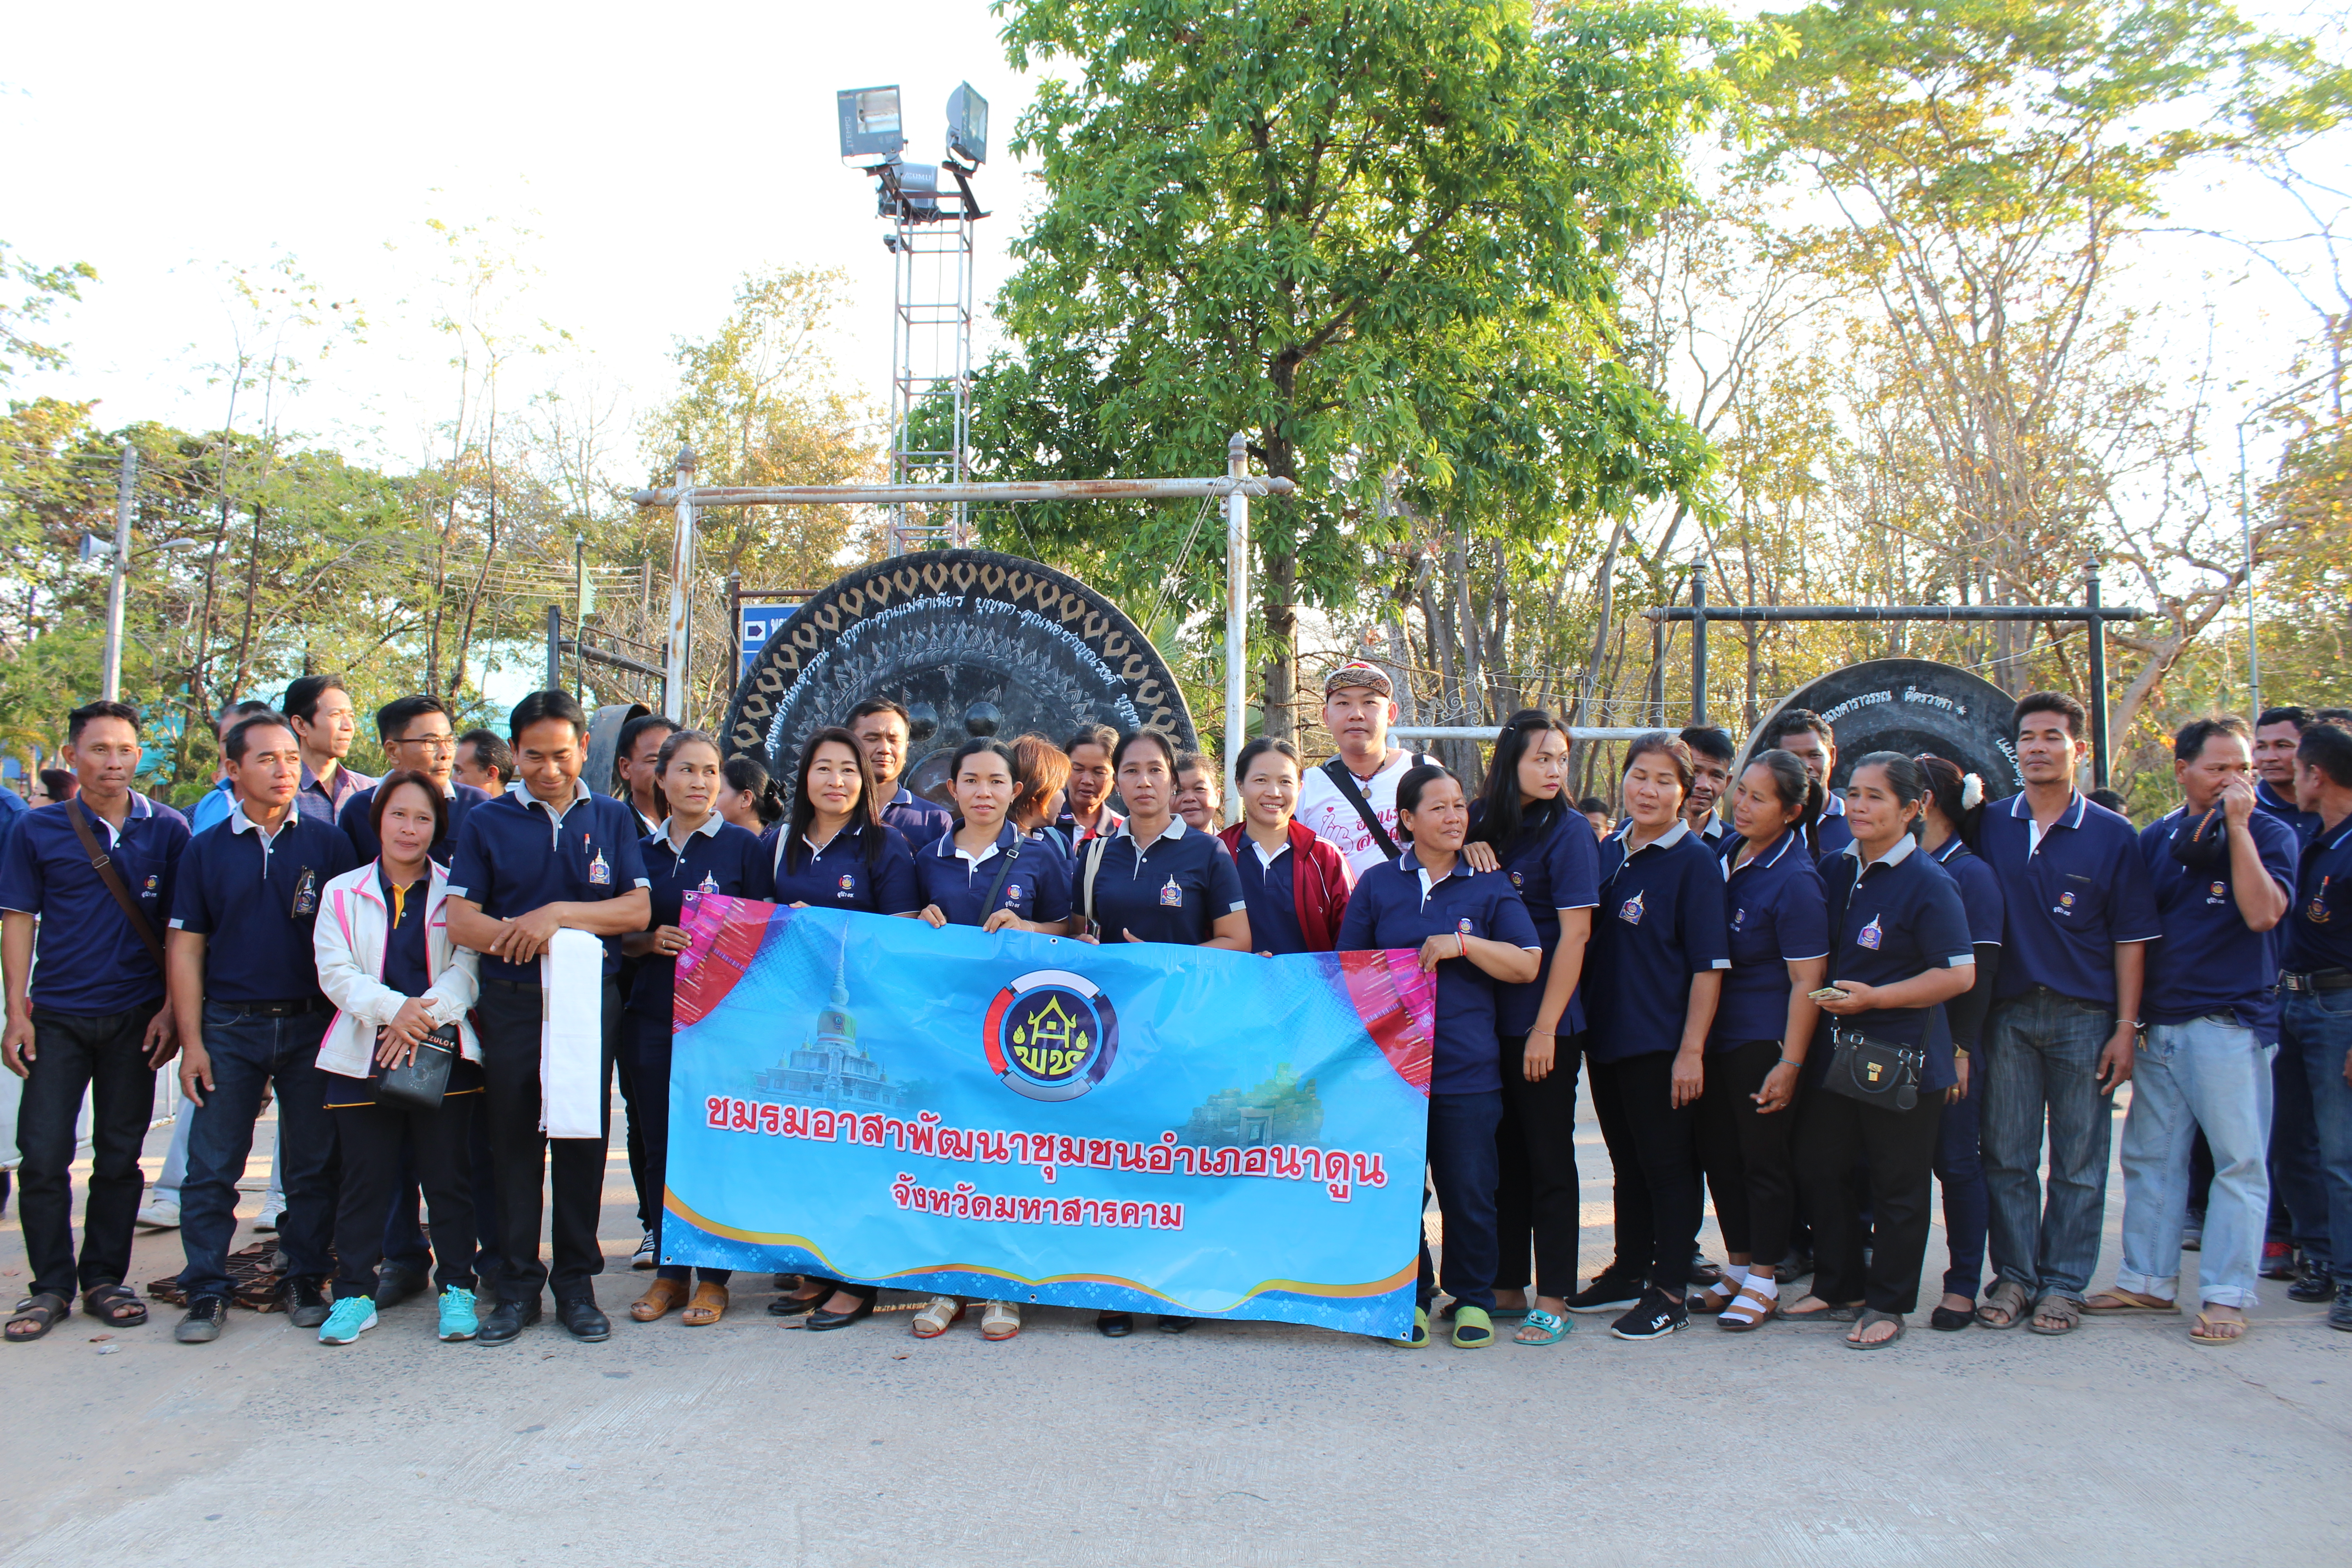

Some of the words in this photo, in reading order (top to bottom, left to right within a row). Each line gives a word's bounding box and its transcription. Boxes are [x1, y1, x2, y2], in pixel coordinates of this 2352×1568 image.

[706, 1096, 1387, 1201] ชมรมอาสาพัฒนาชุมชนอำเภอนาดูน
[891, 1173, 1183, 1230] จังหวัดมหาสารคาม
